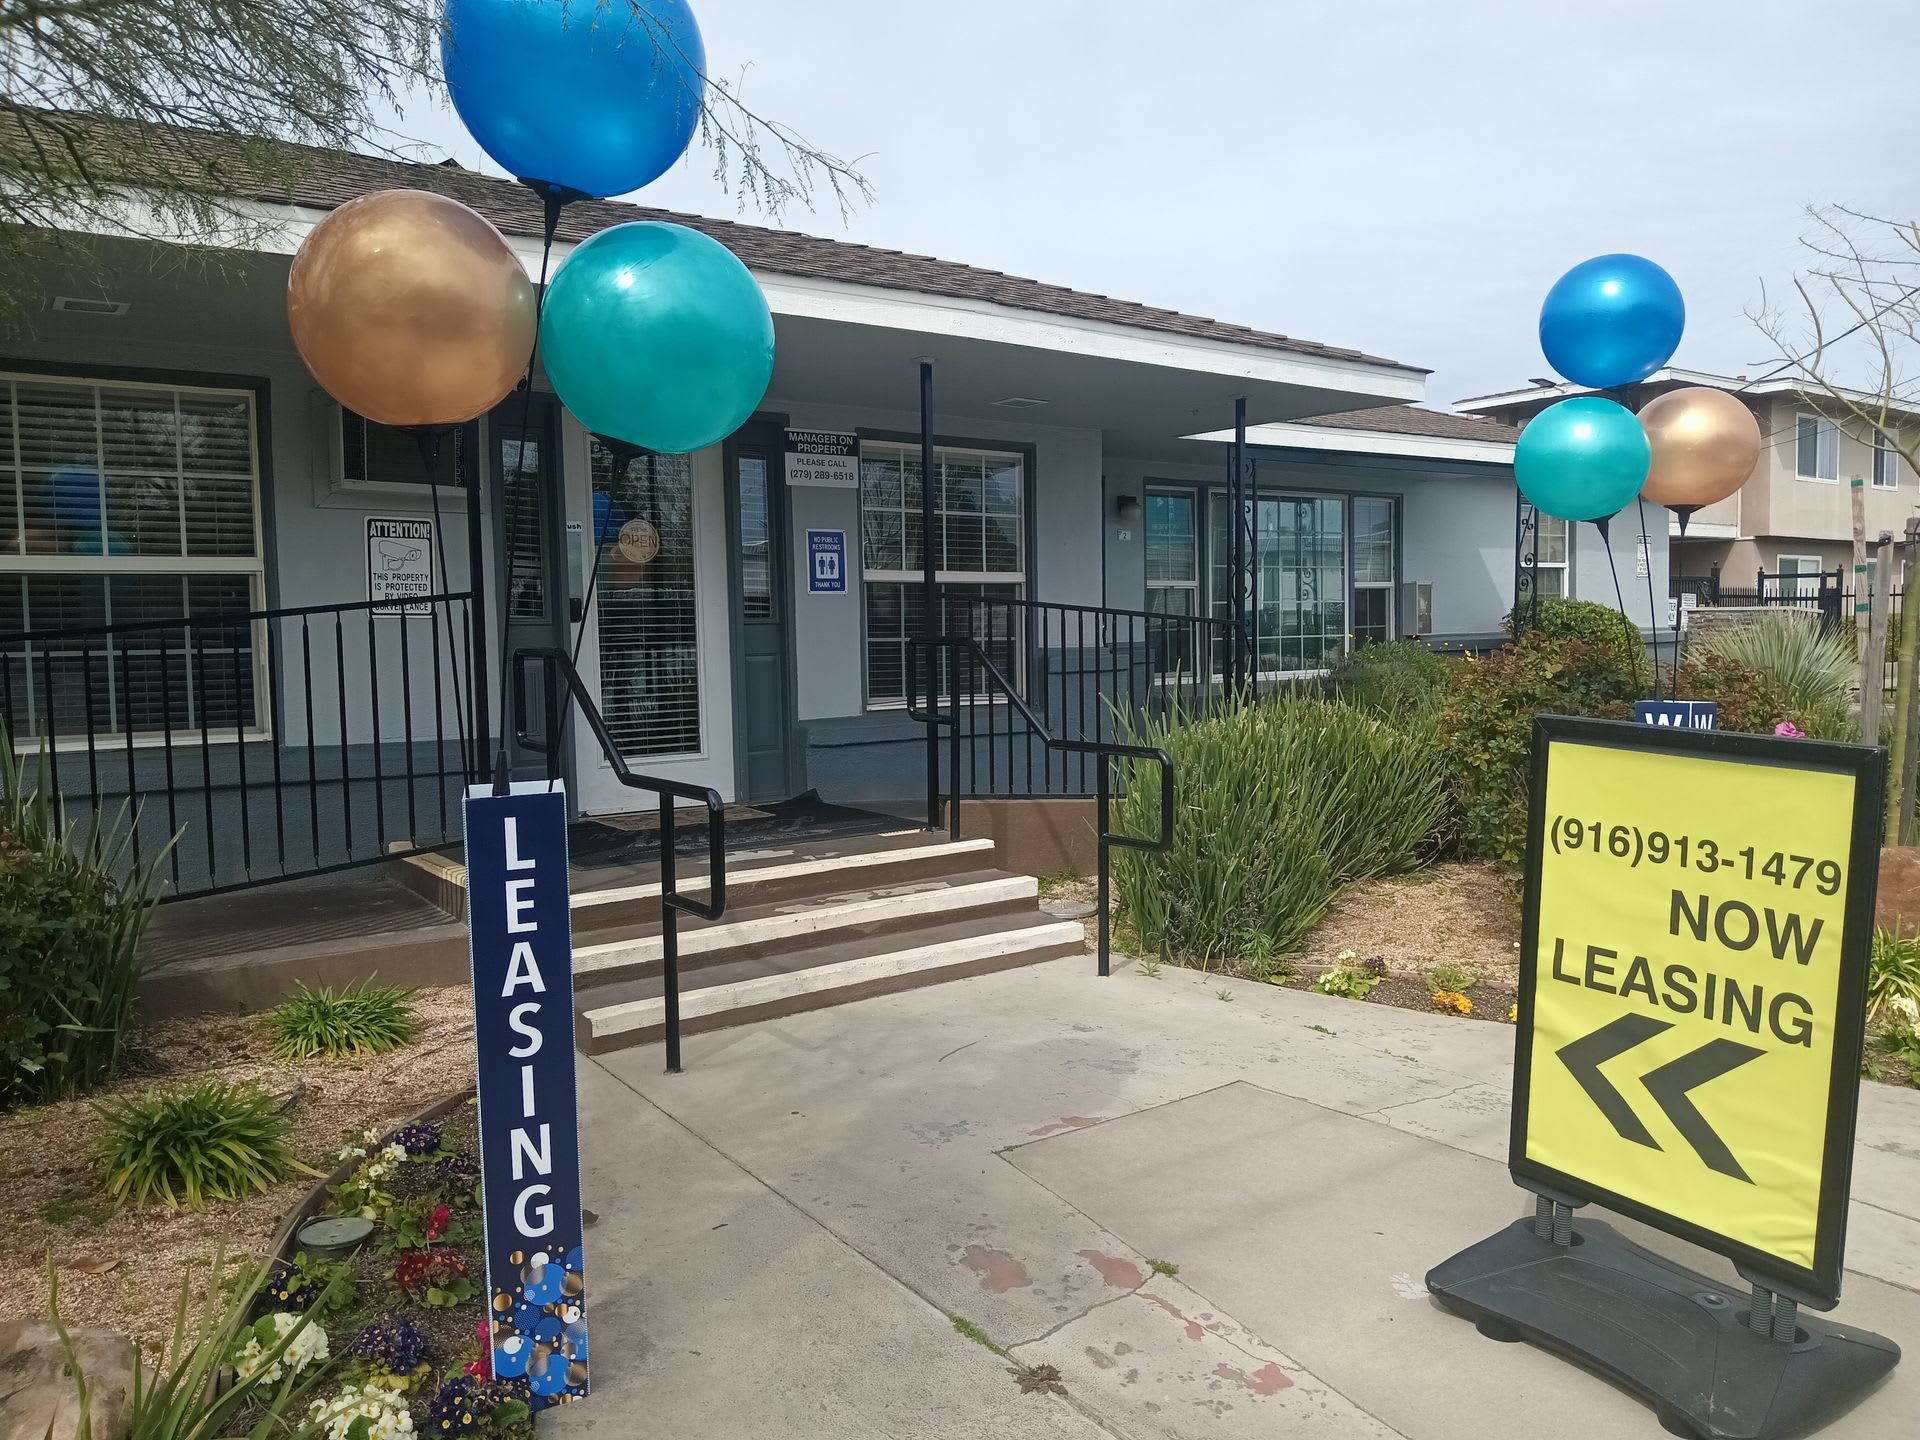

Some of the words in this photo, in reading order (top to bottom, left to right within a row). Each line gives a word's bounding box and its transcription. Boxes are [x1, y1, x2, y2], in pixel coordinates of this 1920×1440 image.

[789, 432, 837, 444] MANAGER
[839, 436, 853, 445] ON
[797, 443, 849, 455] PROPERTY
[796, 458, 826, 467] PLEASE
[827, 460, 848, 468] CALL
[790, 469, 812, 480] (279)
[814, 470, 854, 481] 289-6518
[370, 522, 430, 538] ATTENTION!
[620, 534, 658, 548] OPEN
[812, 543, 841, 551] RESTROOMS
[373, 572, 389, 581] THIS
[392, 573, 429, 582] PROPERTY
[374, 582, 382, 591] IS
[385, 583, 428, 592] PROTECTED
[384, 592, 394, 600] BY
[1550, 815, 1842, 896] (916)913-1479
[1668, 888, 1824, 966] NOW
[1552, 937, 1814, 1048] LEASING
[501, 815, 556, 1239] LEASING
